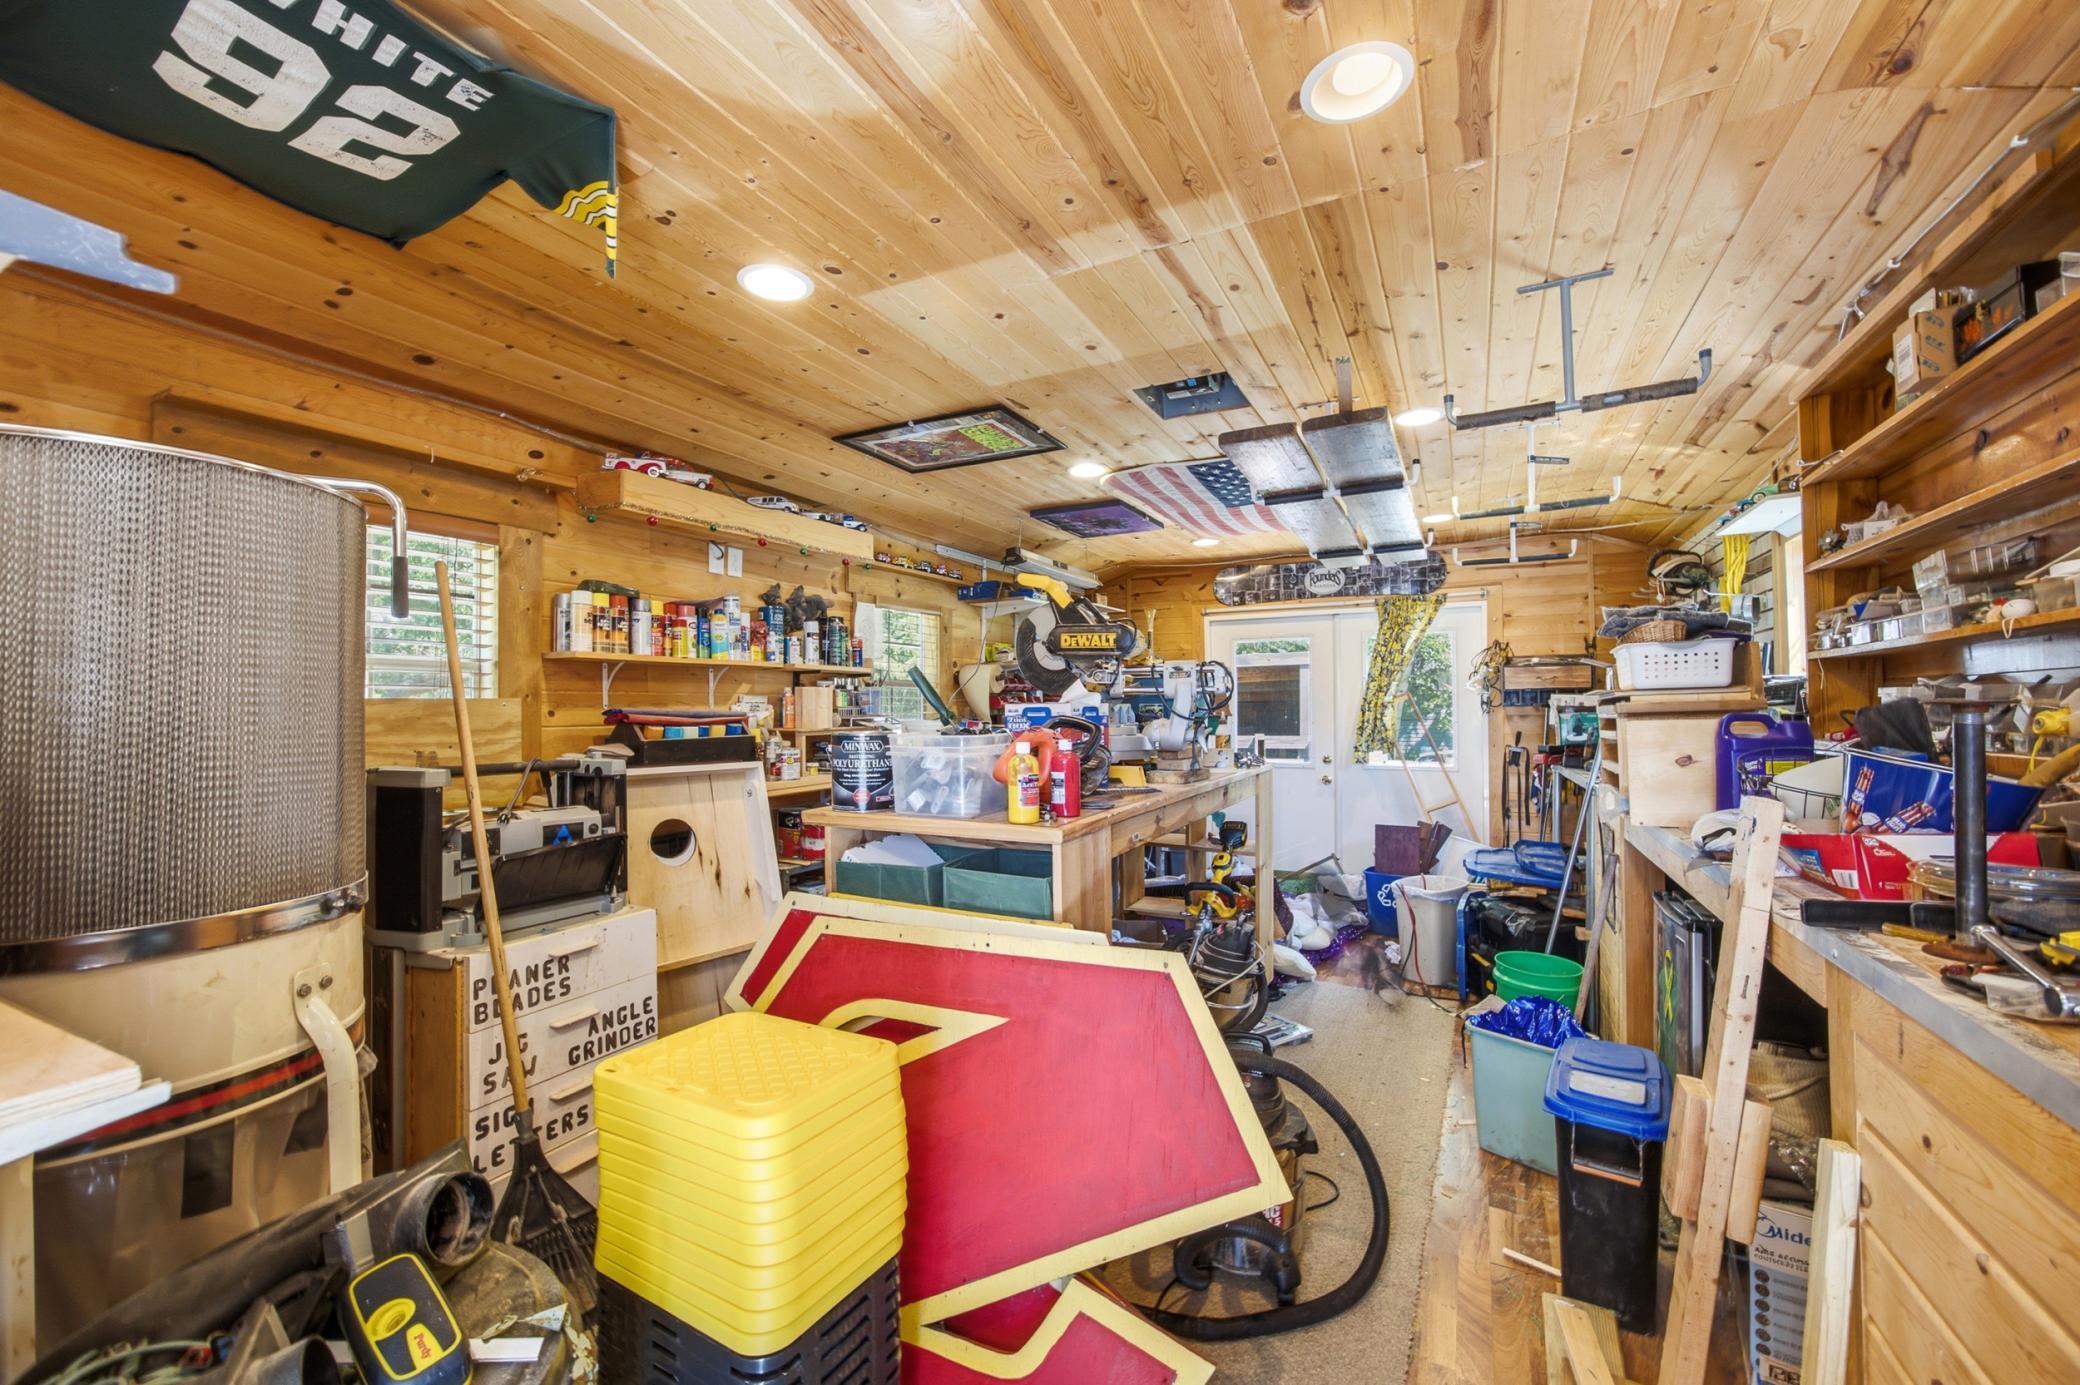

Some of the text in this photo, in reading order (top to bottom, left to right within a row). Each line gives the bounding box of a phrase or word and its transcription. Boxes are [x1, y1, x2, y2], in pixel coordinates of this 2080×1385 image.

[266, 0, 495, 111] HITE
[151, 0, 461, 180] 92
[843, 741, 881, 751] MINWAX
[588, 996, 653, 1037] ANGLE
[488, 1032, 528, 1065] JG
[568, 1016, 656, 1066] GRINDER
[473, 1104, 589, 1174] LEERS
[413, 1333, 432, 1360] Purdy
